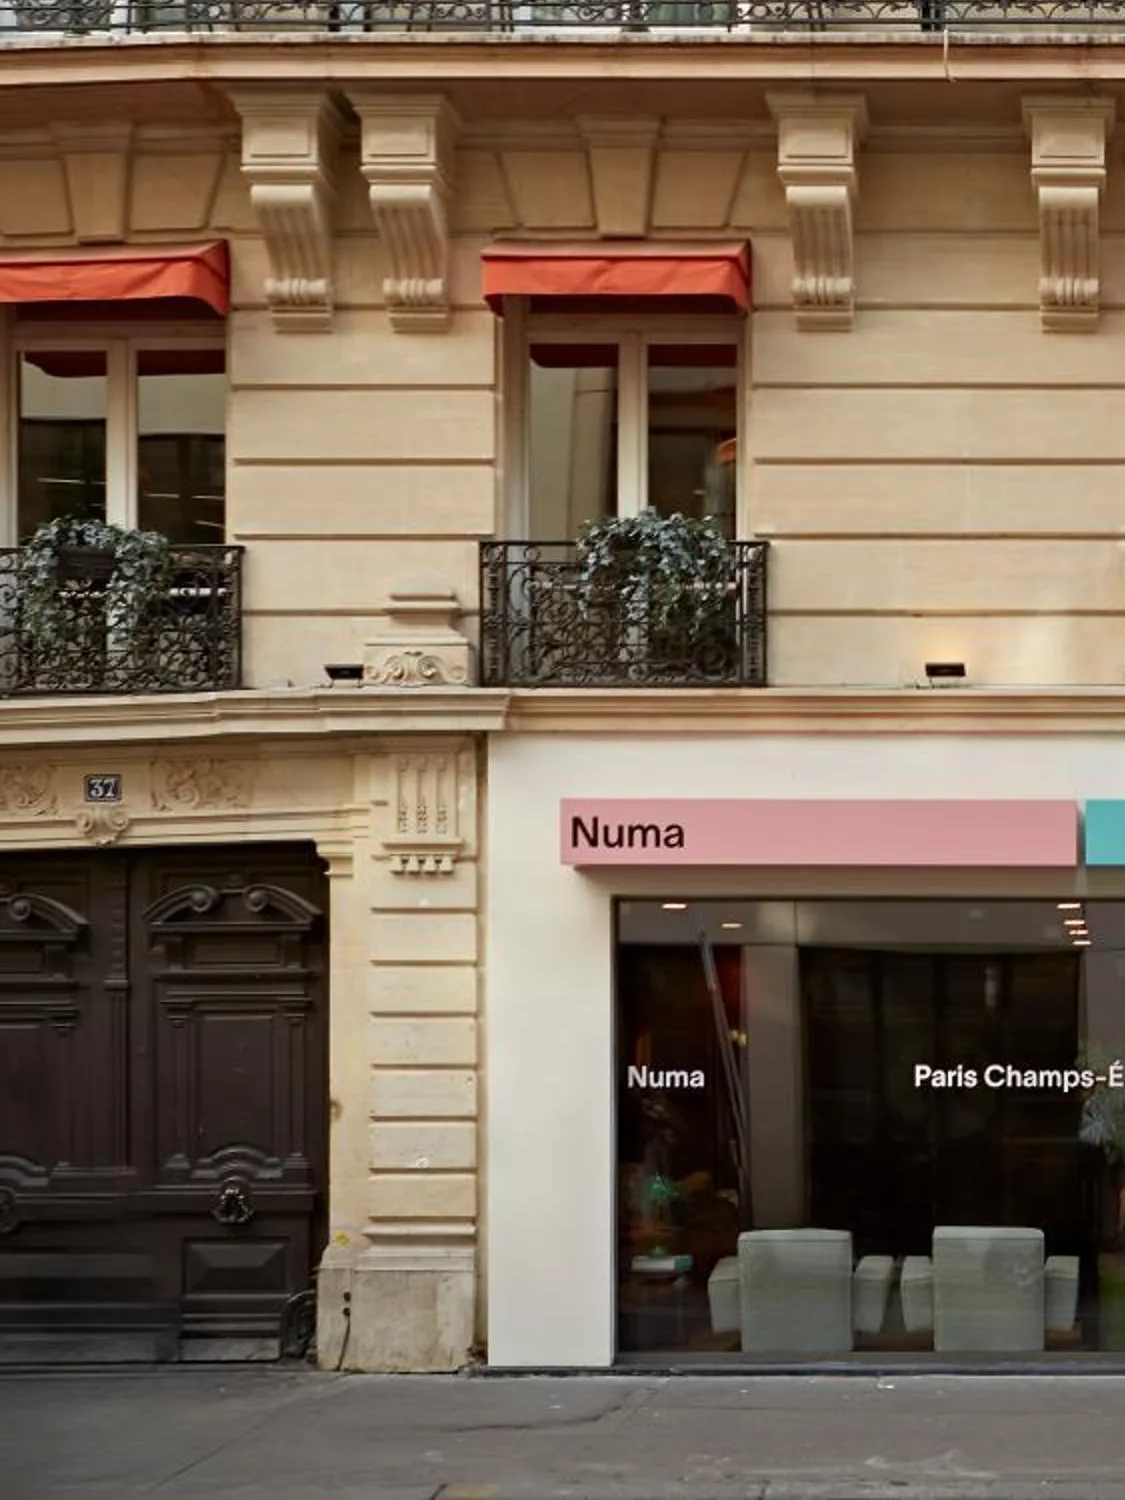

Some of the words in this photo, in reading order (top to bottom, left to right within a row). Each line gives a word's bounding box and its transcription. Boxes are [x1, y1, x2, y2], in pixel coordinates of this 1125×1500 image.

[90, 778, 115, 797] 37
[571, 816, 685, 849] Numa
[628, 1065, 705, 1088] Numa
[914, 1064, 978, 1088] Paris
